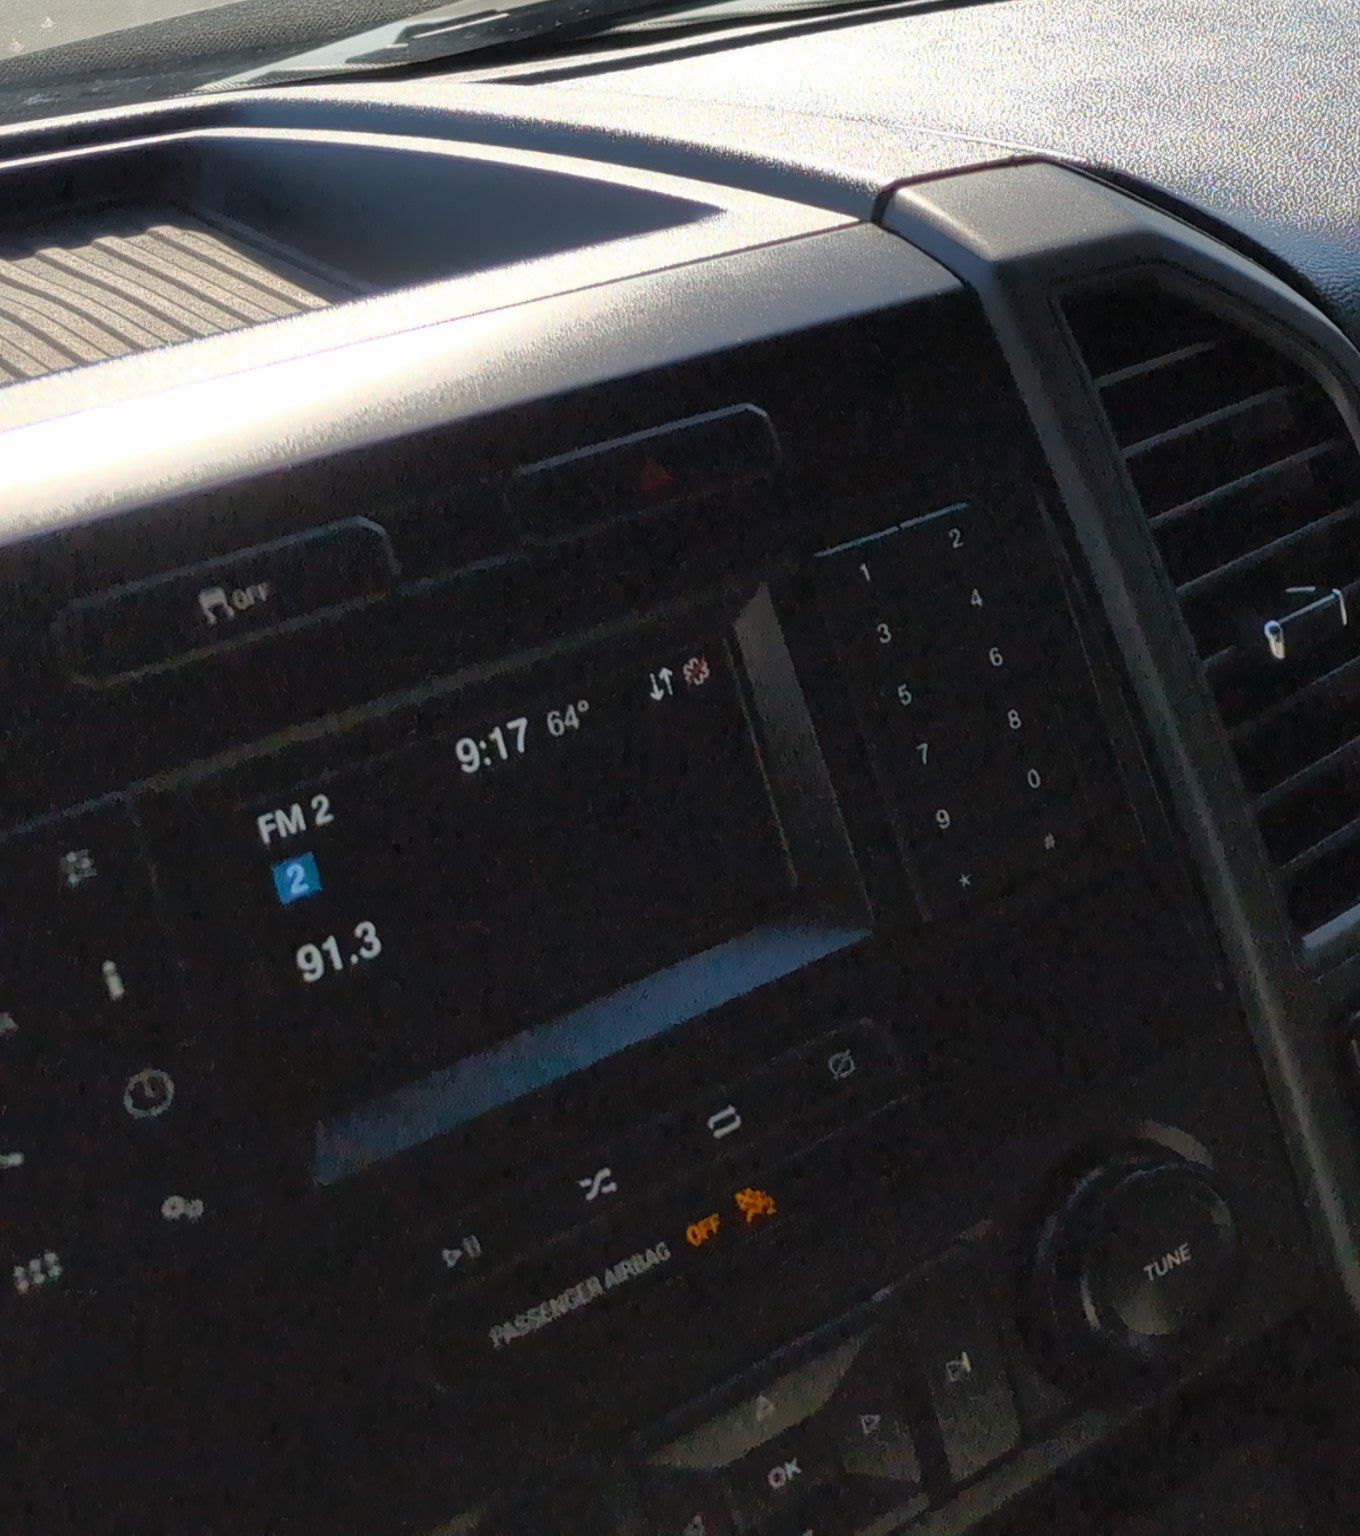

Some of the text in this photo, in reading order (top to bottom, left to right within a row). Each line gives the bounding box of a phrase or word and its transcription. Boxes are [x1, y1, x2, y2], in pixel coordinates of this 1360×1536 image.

[949, 528, 963, 549] 2
[860, 563, 871, 582] 1
[970, 588, 983, 607] 4
[877, 623, 892, 644] 3
[989, 647, 1004, 667] 6
[897, 683, 912, 705] 5
[1007, 709, 1022, 730] 8
[455, 700, 590, 773] 9:17 64°
[916, 742, 929, 765] 7
[1027, 768, 1041, 789] 0
[257, 794, 334, 845] FM 2
[935, 809, 950, 830] 9
[286, 863, 310, 895] 2
[296, 920, 382, 983] 91.3
[603, 1241, 672, 1289] AIRBAG
[686, 1213, 721, 1247] OFF
[1143, 1242, 1192, 1281] TUNE
[767, 1456, 802, 1489] OK
